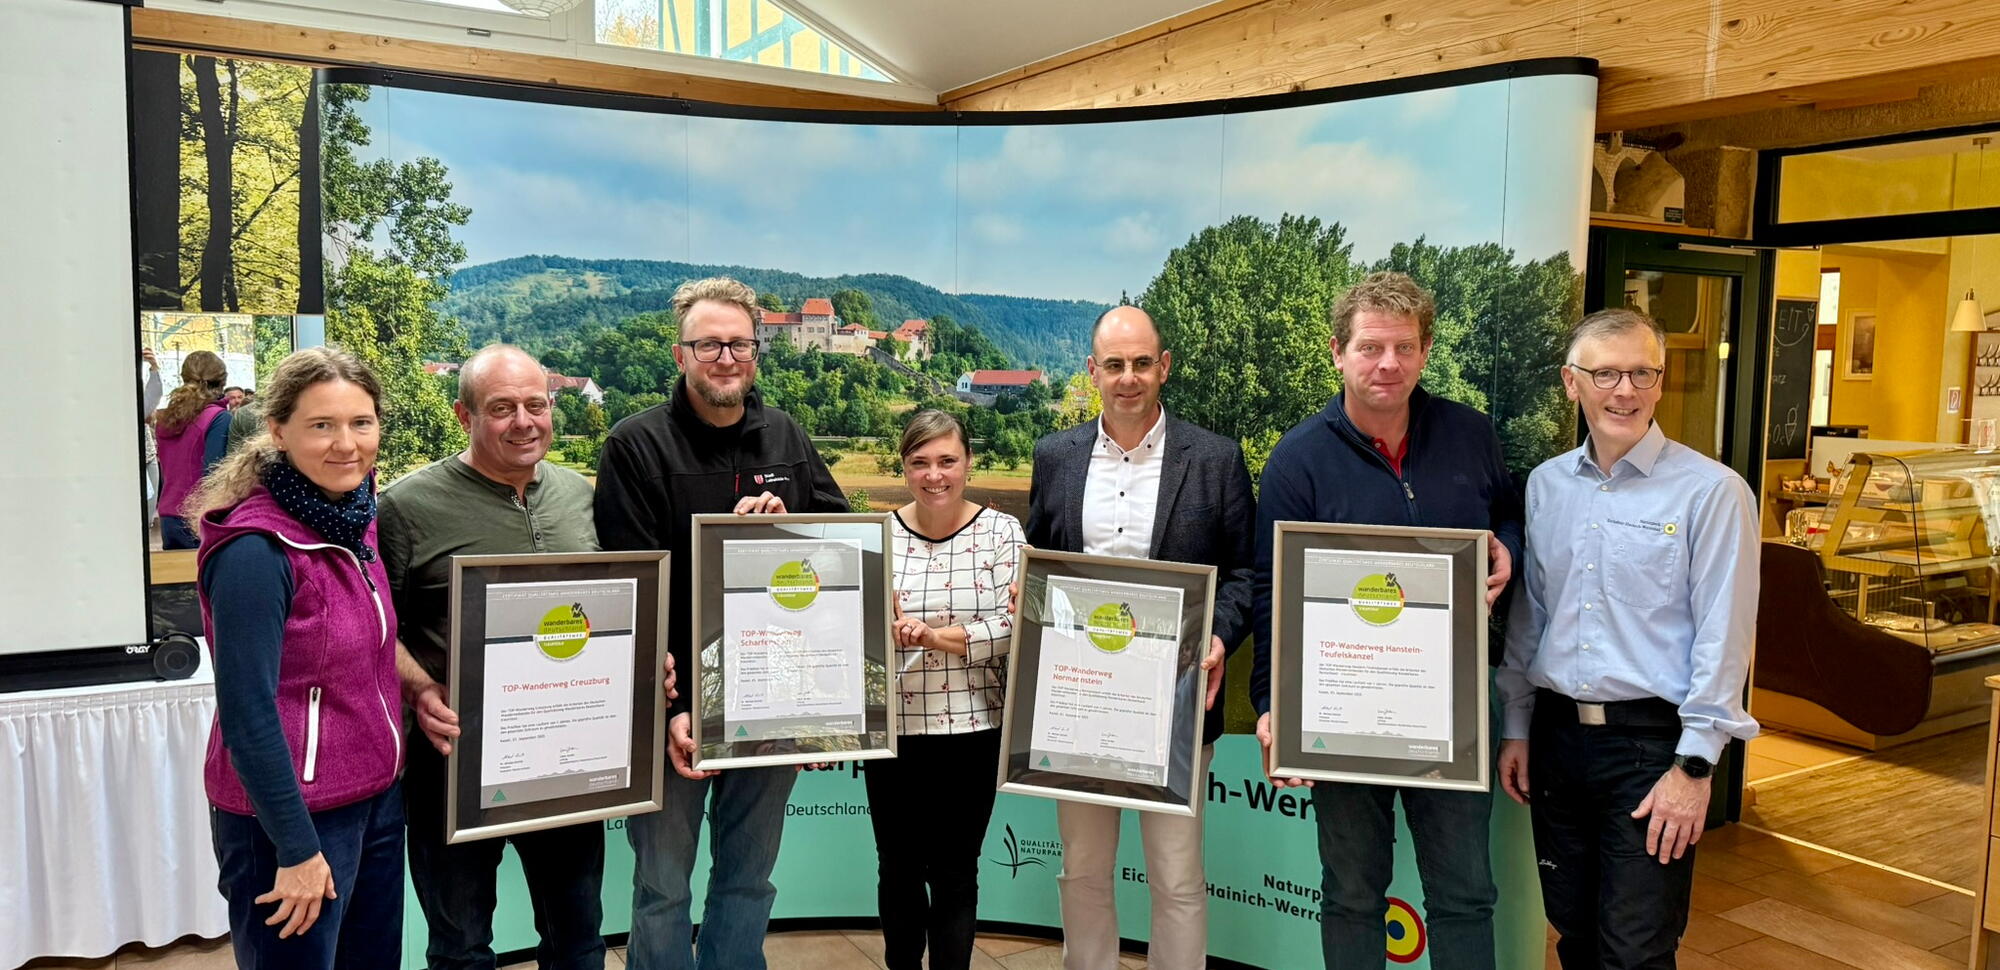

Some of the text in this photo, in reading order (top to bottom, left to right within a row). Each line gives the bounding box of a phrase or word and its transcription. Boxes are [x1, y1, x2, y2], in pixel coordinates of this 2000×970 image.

[1319, 640, 1424, 655] TOP-Wanderweg Hanstein-
[1319, 650, 1374, 661] Teufelskanzel
[1054, 663, 1113, 679] TOP-Wanderweg
[502, 676, 611, 694] TOP-Wanderweg Creuzburg
[1122, 867, 1149, 884] Eic
[1264, 874, 1323, 903] Naturp
